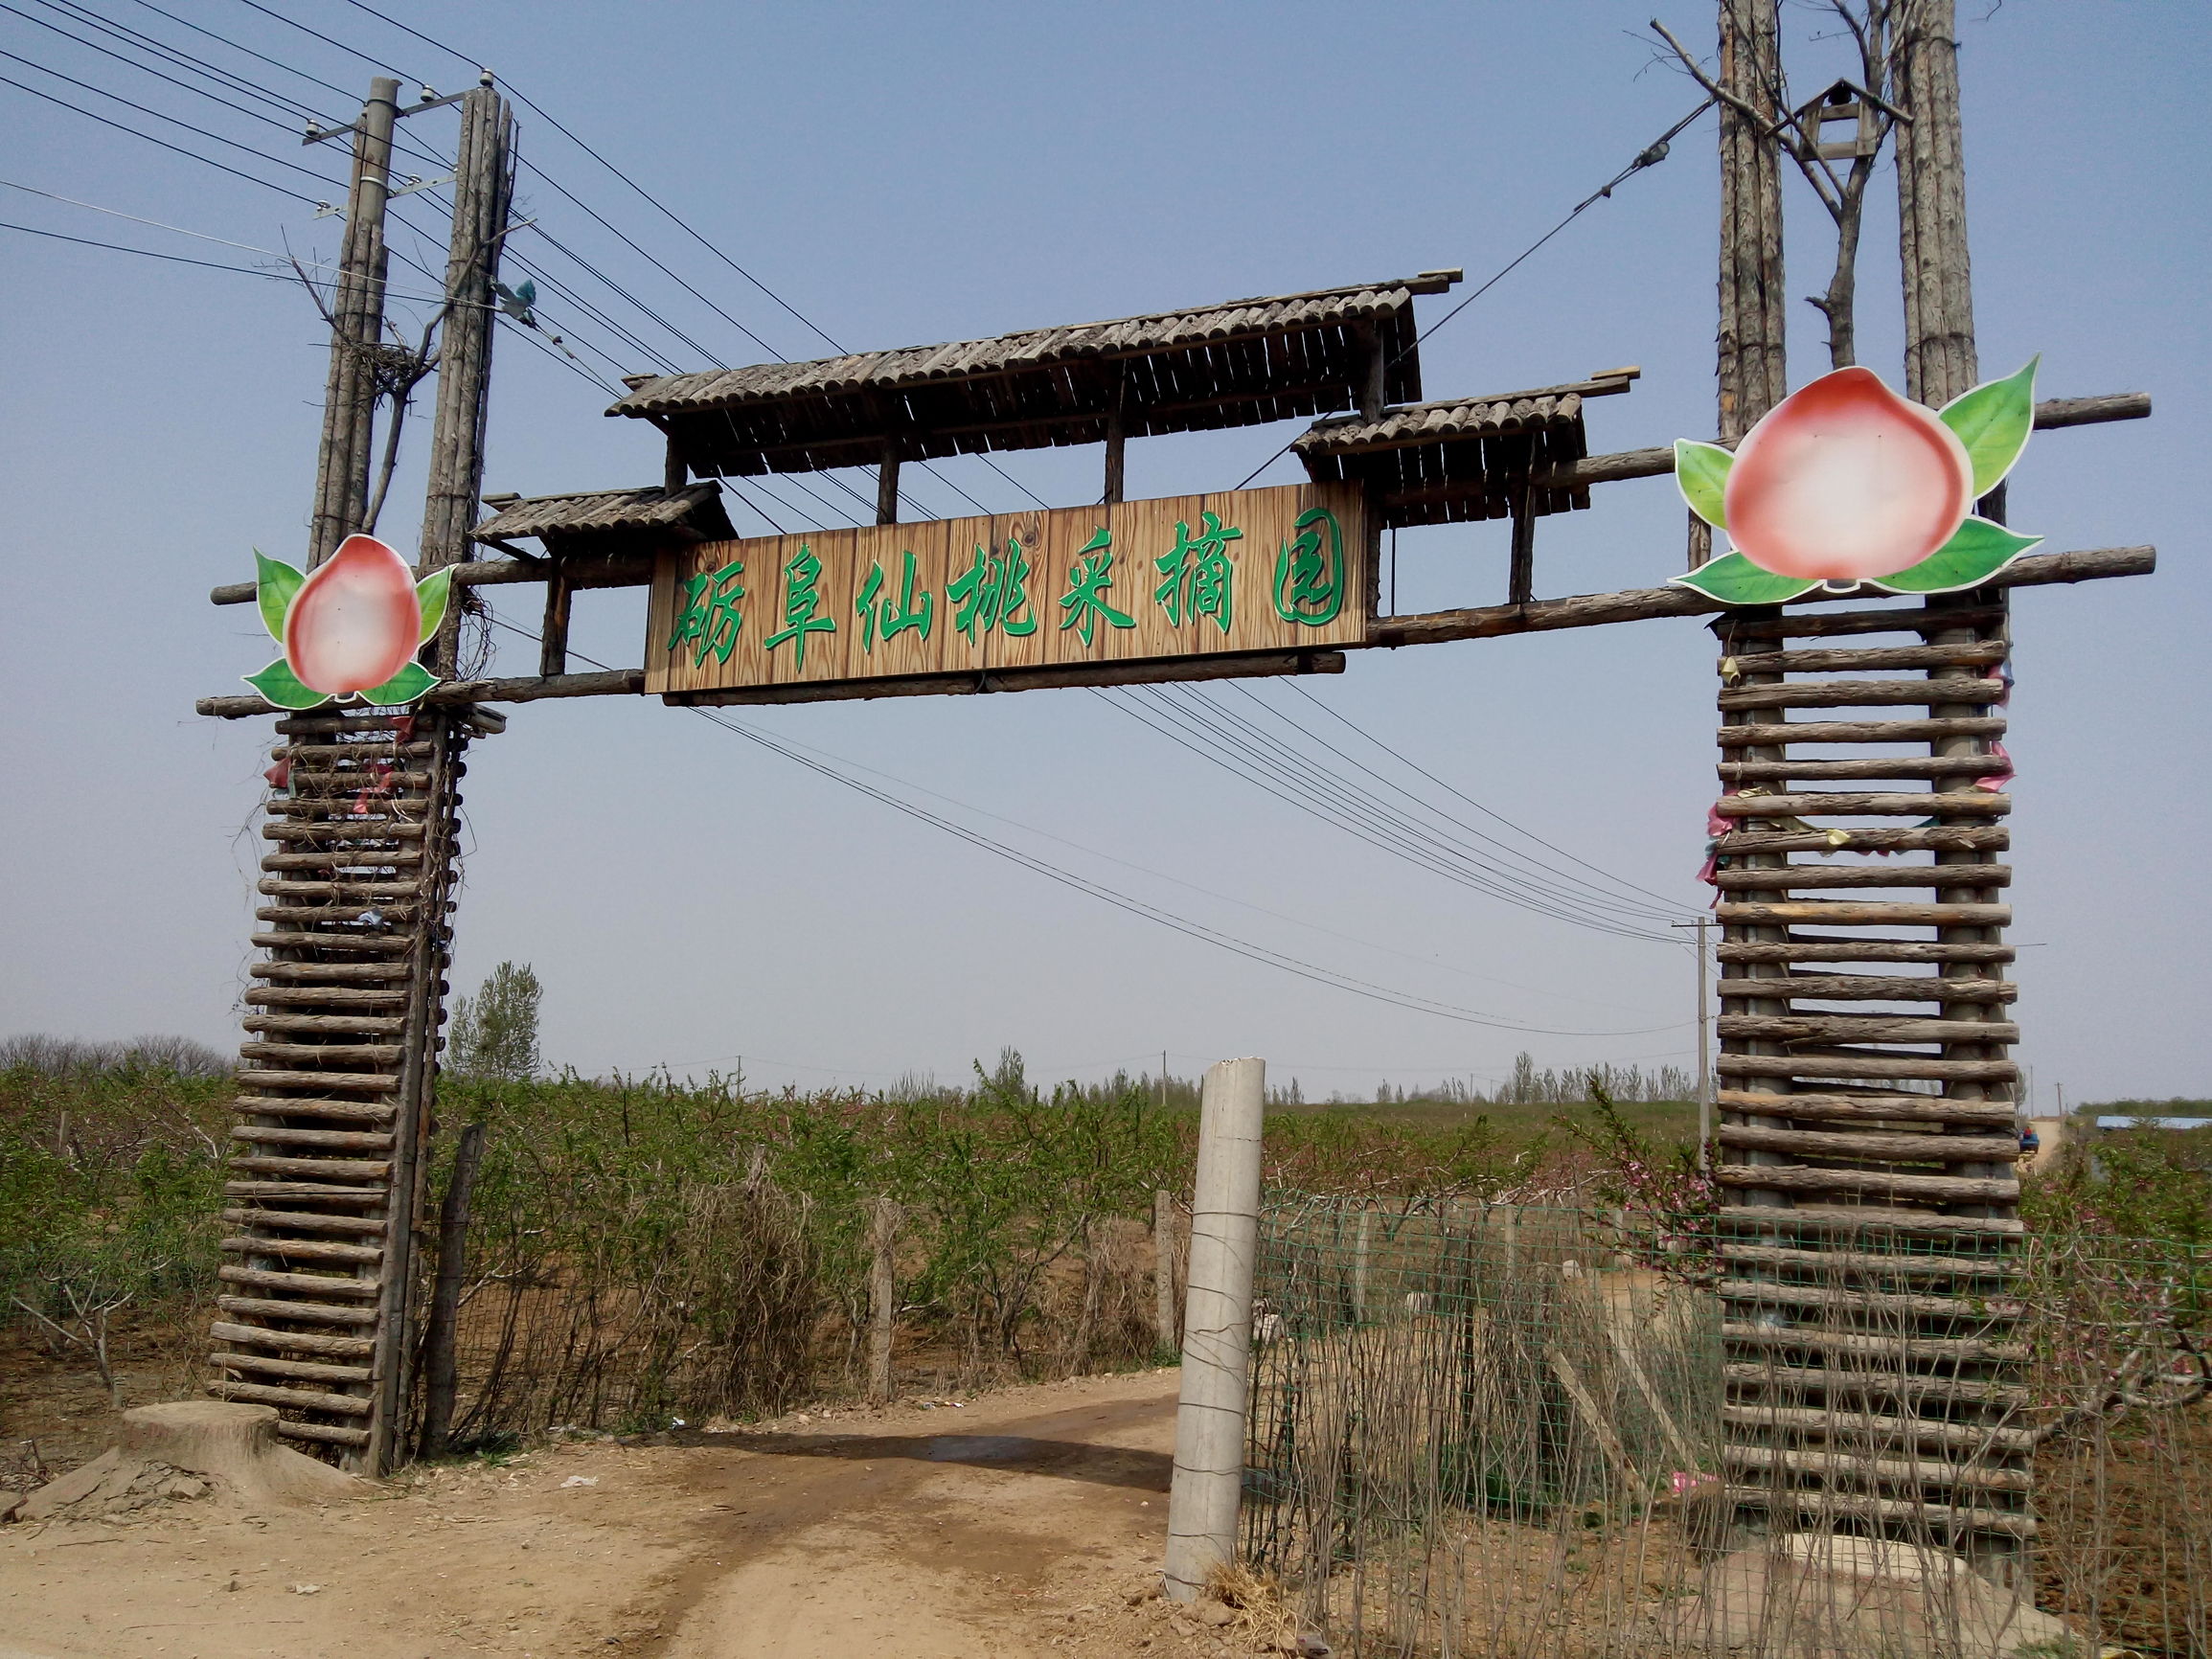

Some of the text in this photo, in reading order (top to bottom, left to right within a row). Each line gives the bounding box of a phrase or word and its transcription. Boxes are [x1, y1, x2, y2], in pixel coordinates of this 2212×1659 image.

[667, 507, 1344, 670] 砺阜仙桃采摘园
